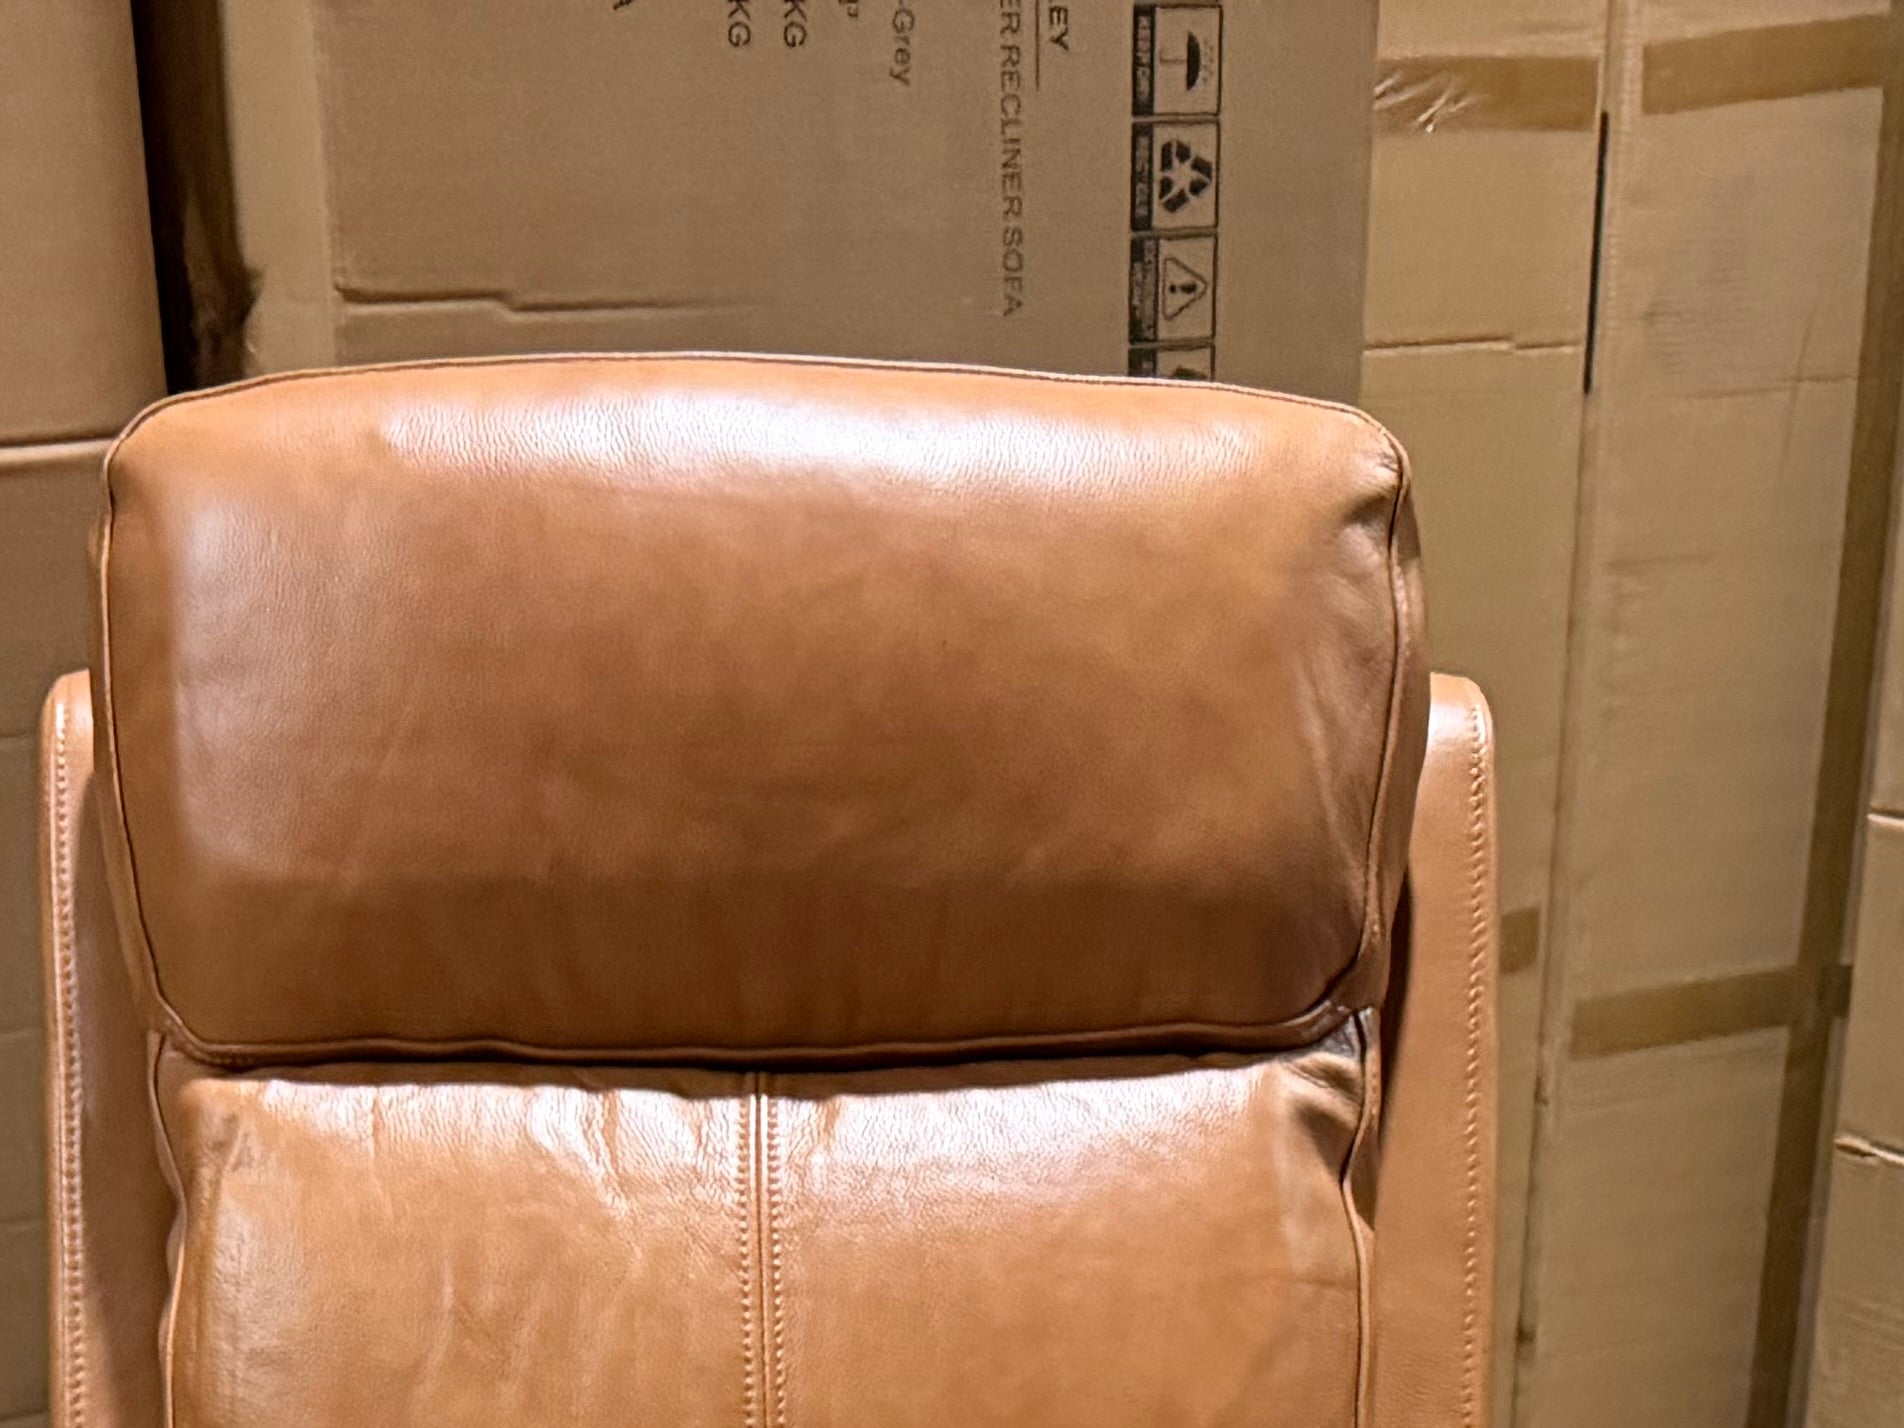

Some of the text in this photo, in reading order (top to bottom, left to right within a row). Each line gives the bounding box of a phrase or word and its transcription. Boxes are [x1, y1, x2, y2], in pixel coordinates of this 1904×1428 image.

[727, 0, 751, 47] KG
[783, 0, 807, 48] KG
[1000, 44, 1024, 218] RECLINER
[1001, 225, 1025, 318] SOFA
